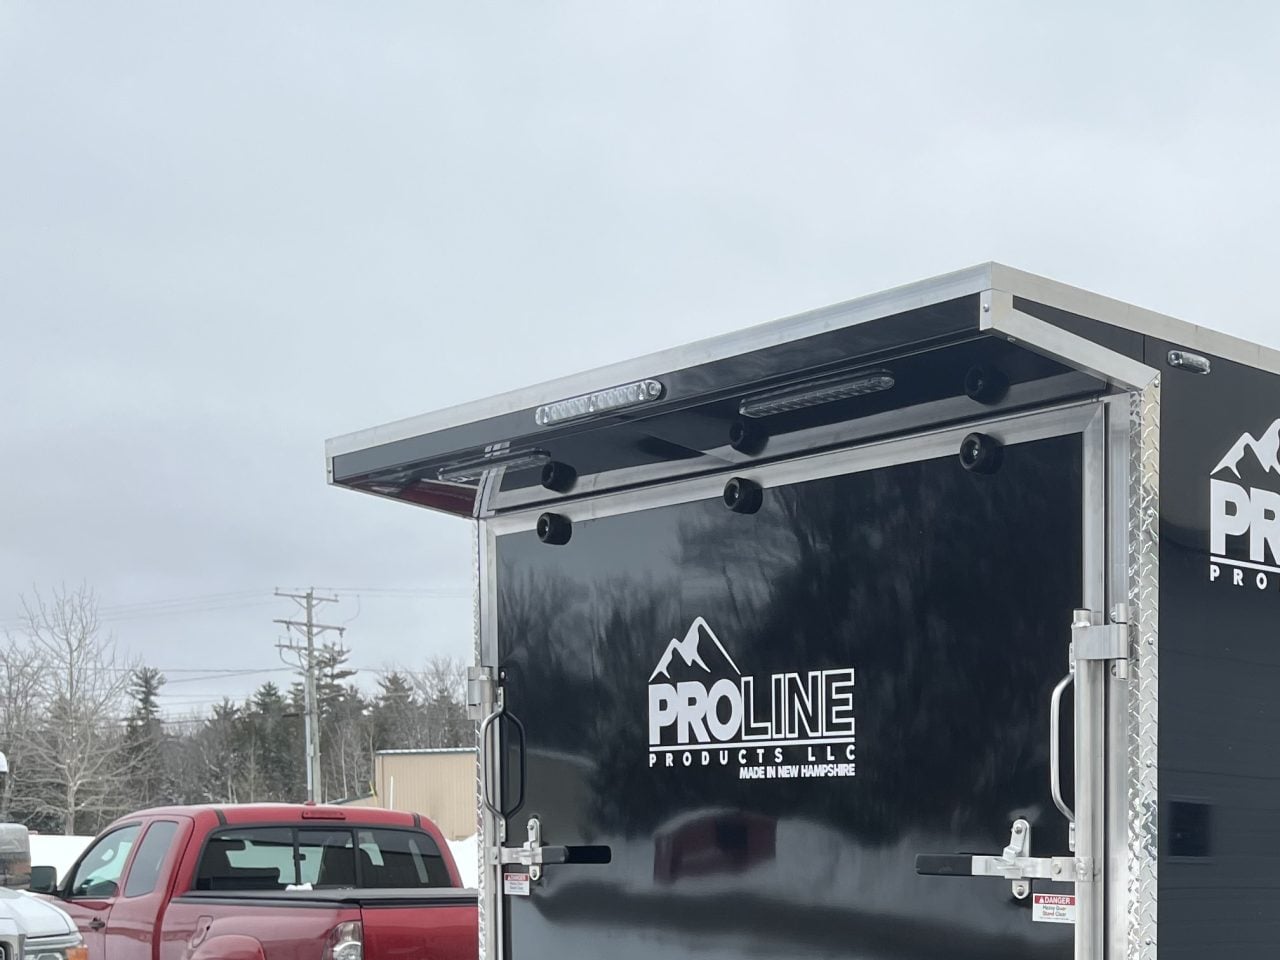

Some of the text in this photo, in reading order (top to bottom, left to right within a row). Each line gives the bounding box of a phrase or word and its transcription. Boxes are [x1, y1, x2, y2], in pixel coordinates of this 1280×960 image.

[648, 667, 856, 746] PROLINE
[649, 745, 856, 768] PRODUCTS LLC
[739, 763, 856, 779] MADE IN NEW HAMPSHIRE
[1044, 896, 1071, 905] DANGER
